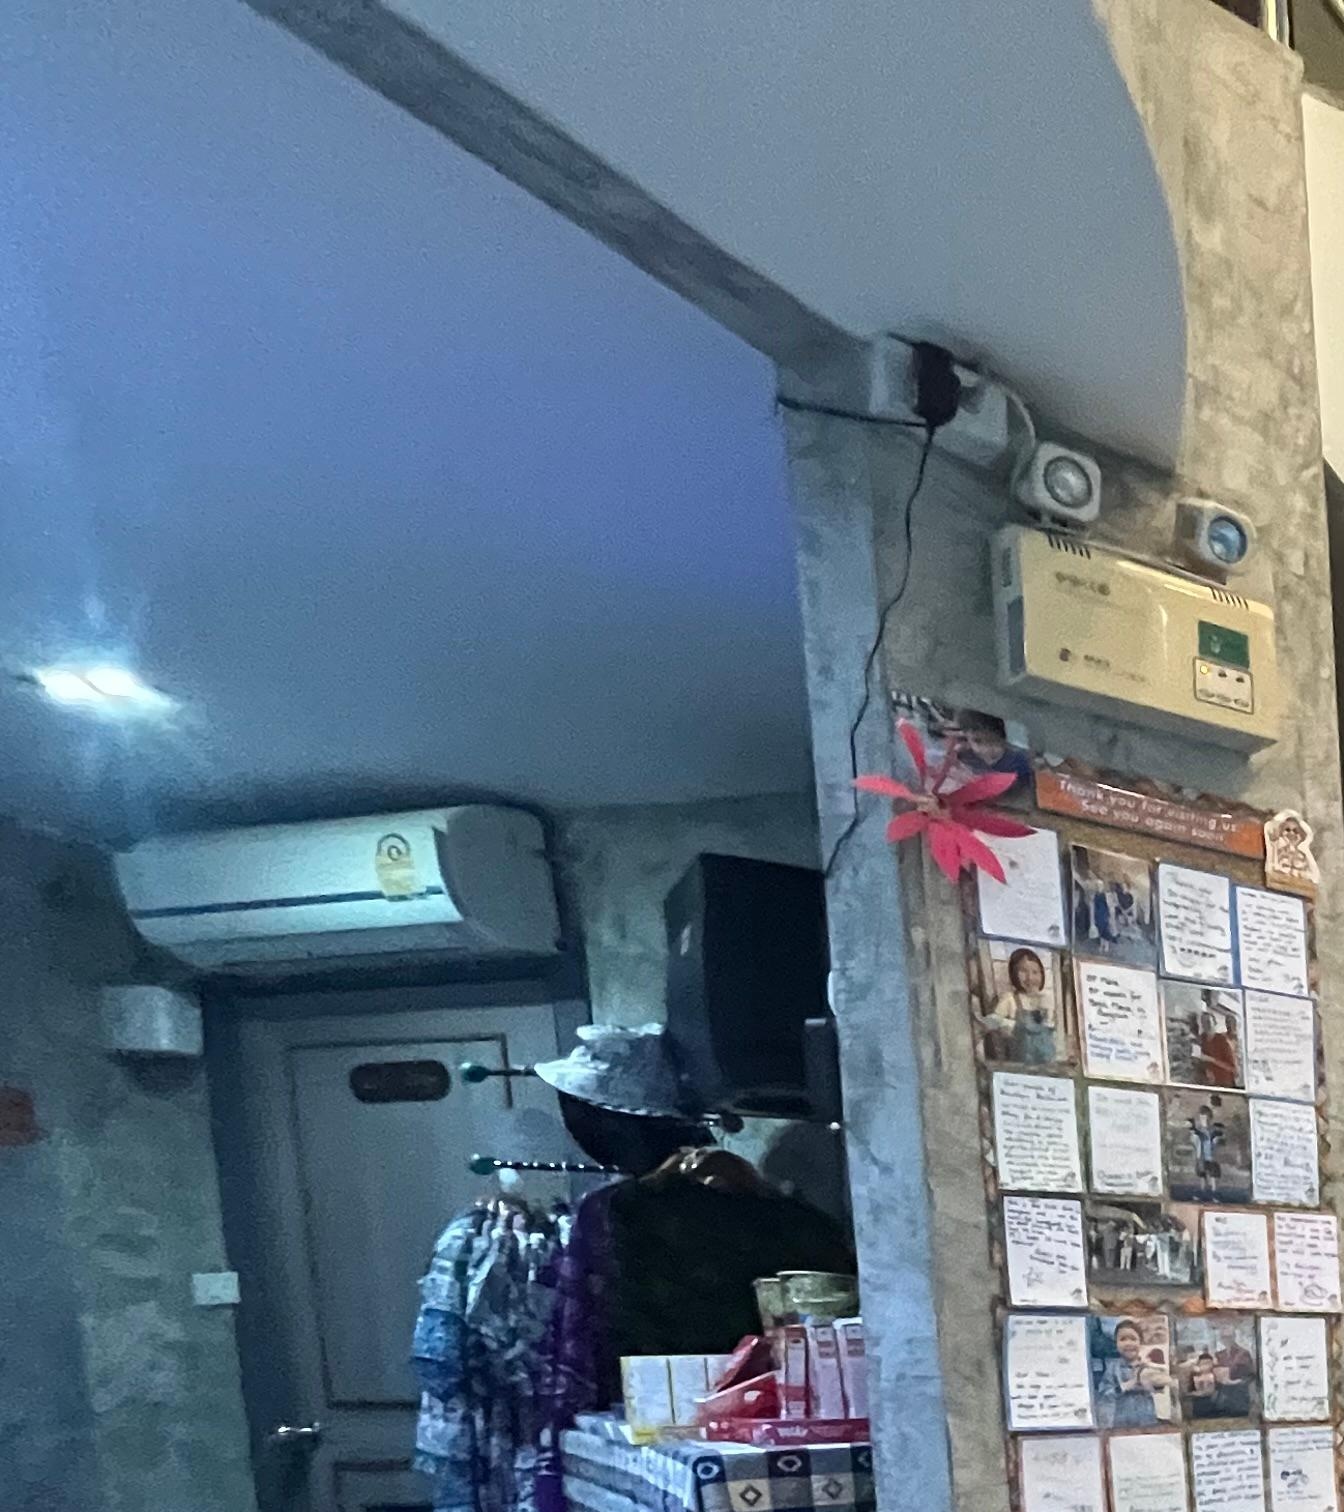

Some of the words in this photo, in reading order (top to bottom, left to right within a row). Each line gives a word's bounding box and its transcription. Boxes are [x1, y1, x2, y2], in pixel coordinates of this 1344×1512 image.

[1060, 779, 1104, 801] Thank
[1109, 796, 1136, 810] you
[1141, 799, 1162, 814] for
[1166, 808, 1218, 831] visiting
[1081, 798, 1109, 816] See
[1113, 810, 1140, 824] you
[1144, 817, 1187, 833] again
